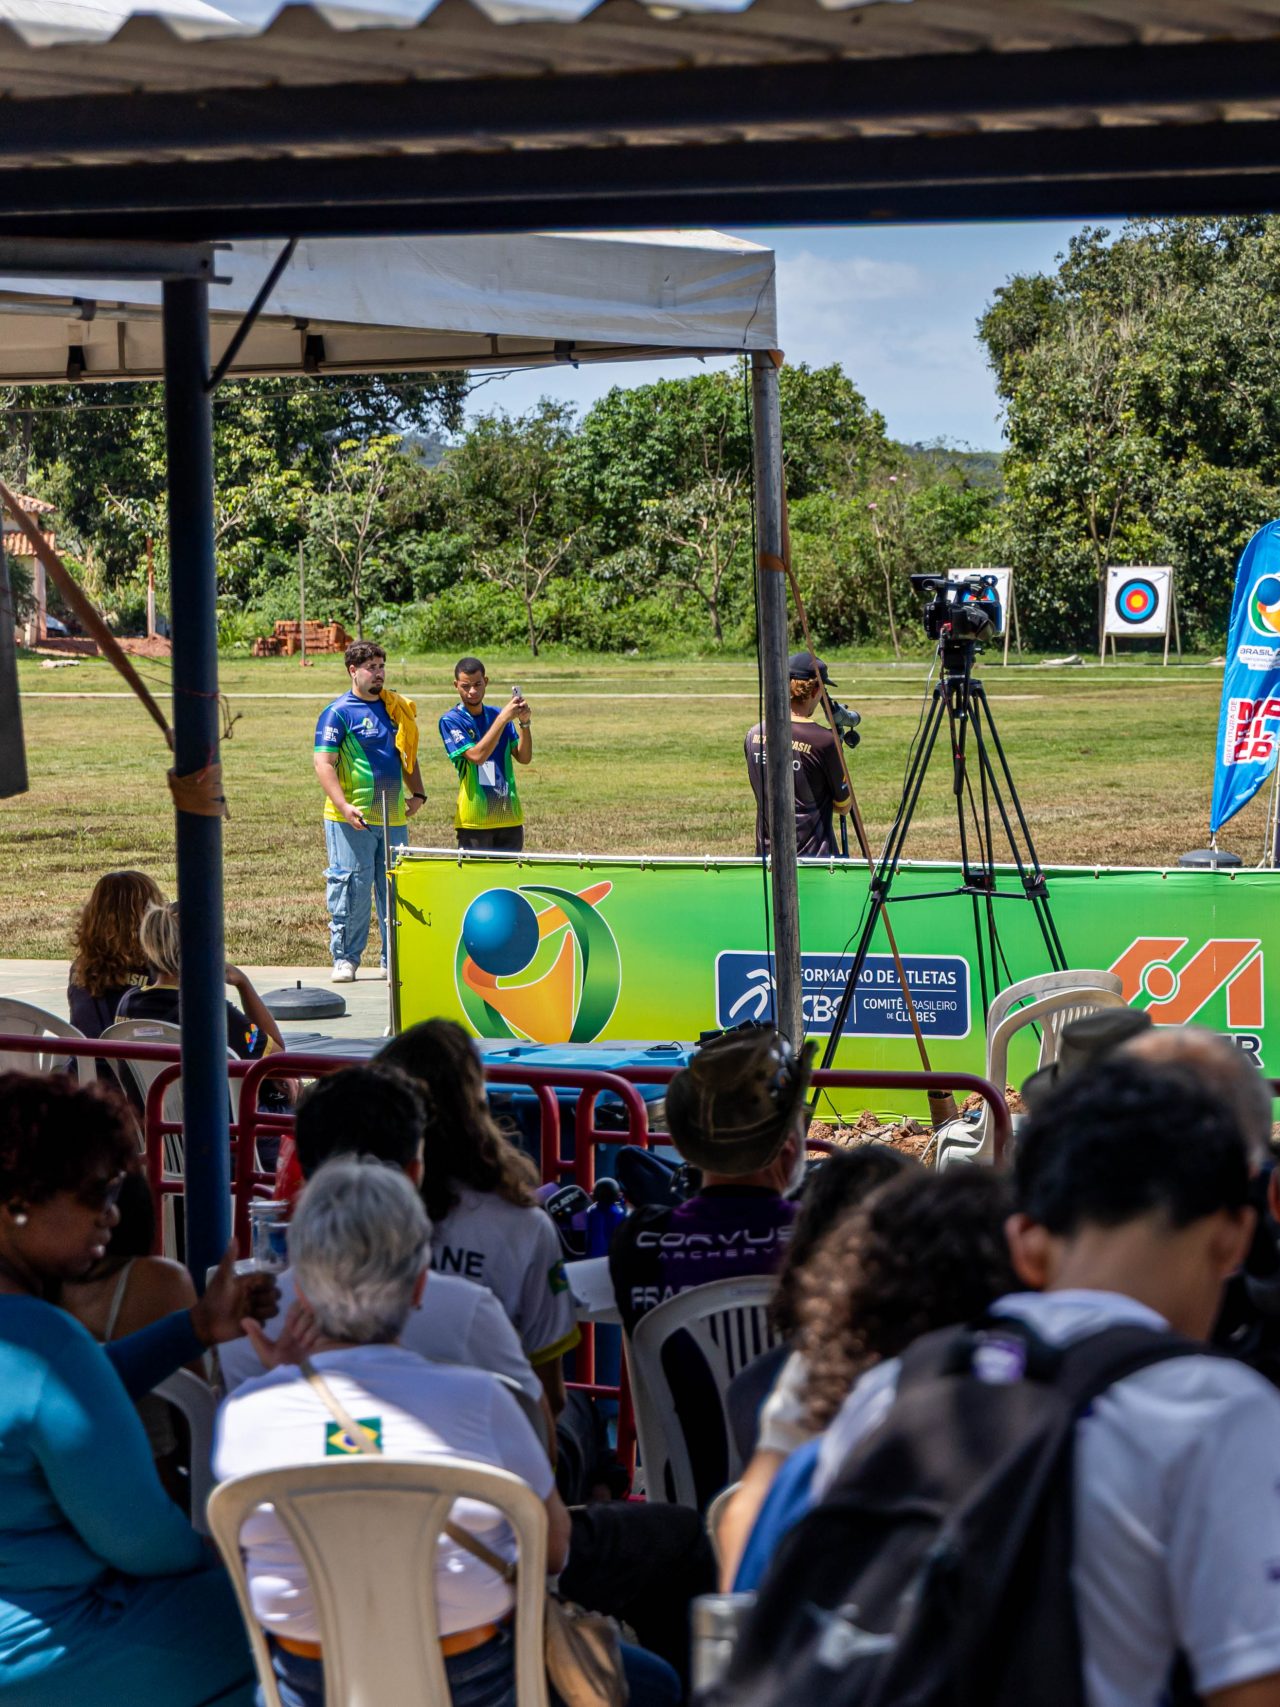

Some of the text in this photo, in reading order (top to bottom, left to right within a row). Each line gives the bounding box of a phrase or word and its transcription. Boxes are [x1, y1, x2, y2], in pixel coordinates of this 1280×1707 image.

[876, 970, 895, 984] DE
[897, 969, 957, 985] TLETAS
[863, 997, 957, 1011] COMITÊ RASILEIRO
[886, 1012, 894, 1020] DE
[636, 1226, 794, 1248] CORVUS
[658, 1247, 774, 1259] ARCHERY
